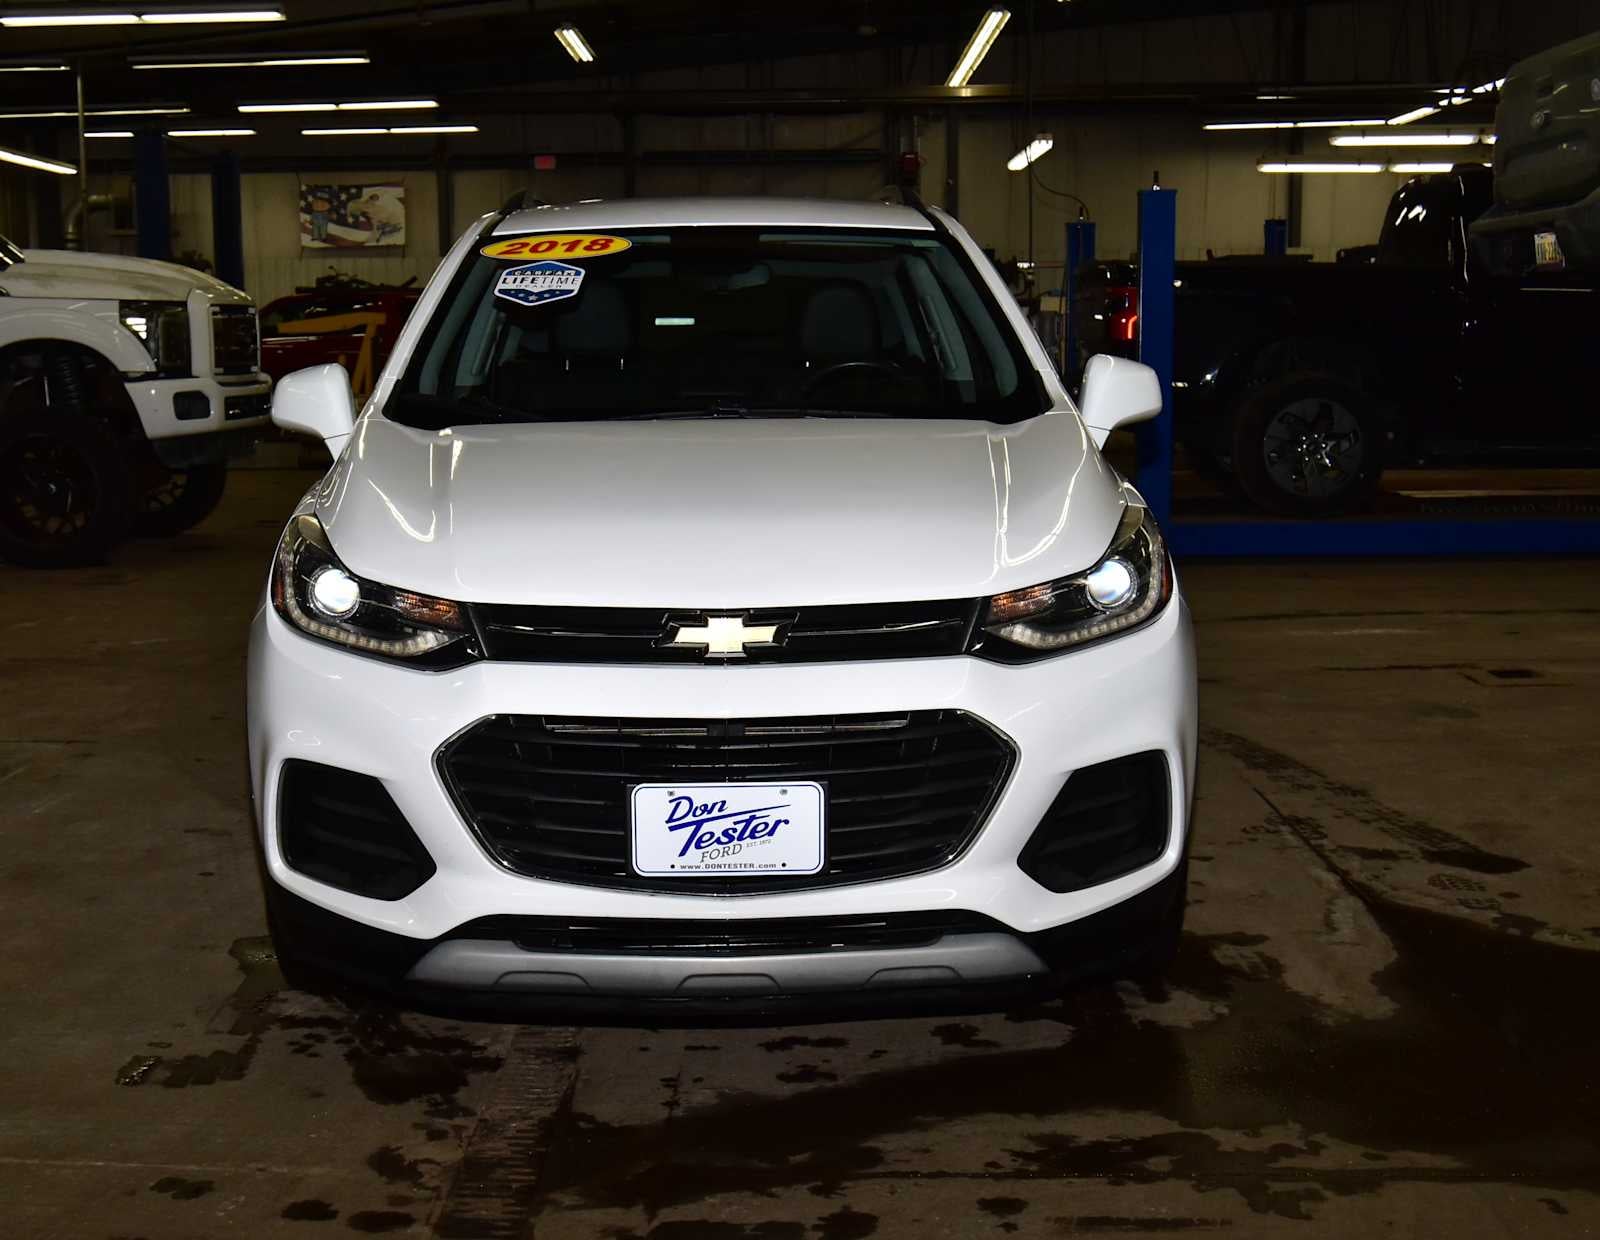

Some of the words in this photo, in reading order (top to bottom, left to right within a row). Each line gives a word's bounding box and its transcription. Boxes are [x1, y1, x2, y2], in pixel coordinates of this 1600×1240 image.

[498, 238, 613, 256] 2018
[501, 276, 580, 285] LIFETIME
[665, 796, 728, 824] Don
[668, 805, 791, 857] Tester
[700, 843, 743, 864] FORD
